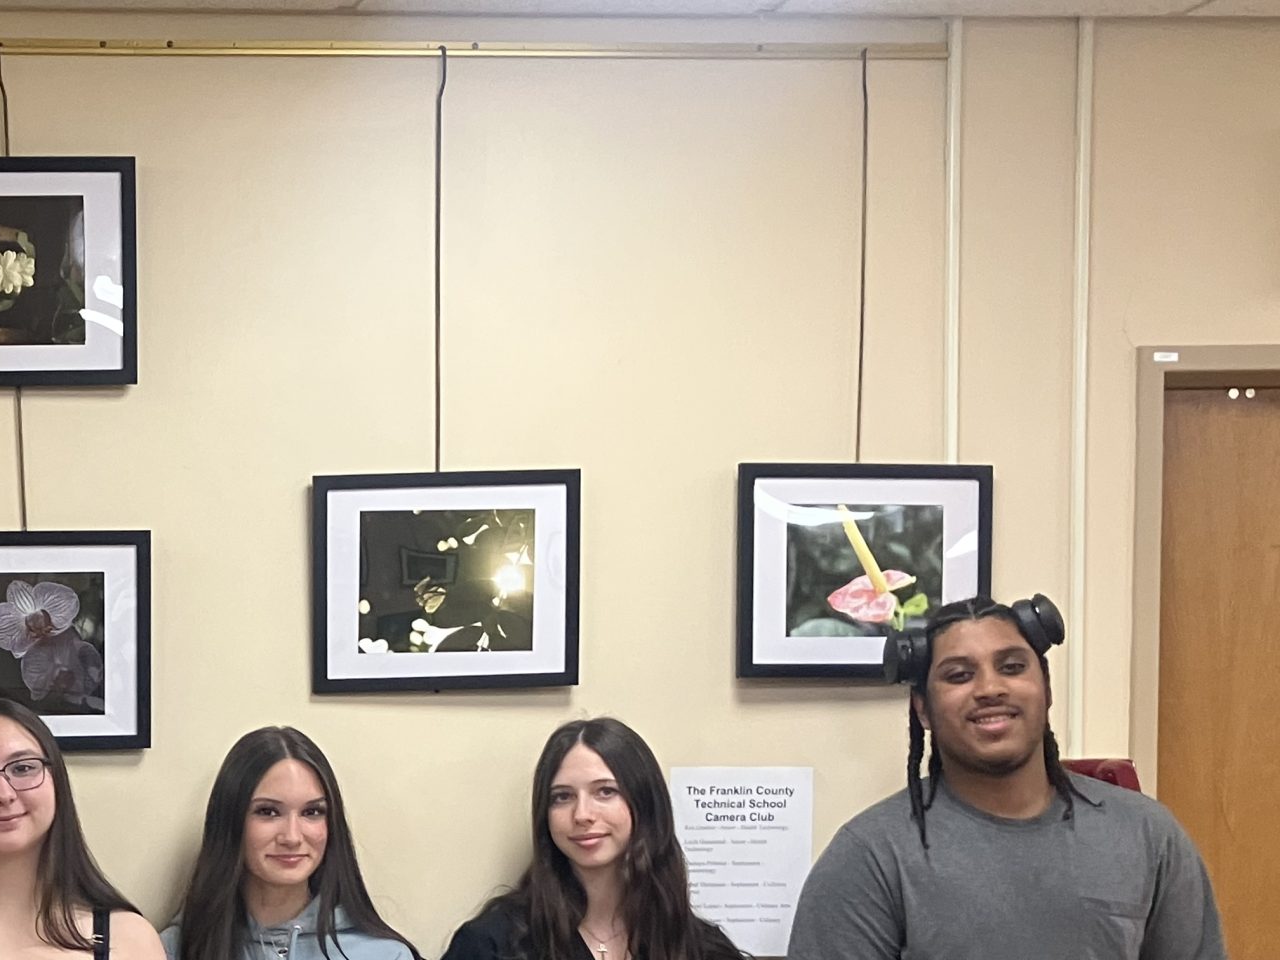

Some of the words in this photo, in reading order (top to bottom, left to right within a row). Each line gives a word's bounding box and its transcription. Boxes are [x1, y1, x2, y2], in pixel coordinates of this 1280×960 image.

[686, 786, 706, 795] The
[709, 786, 753, 795] Franklin
[756, 786, 795, 797] County
[694, 799, 746, 808] Technical
[749, 799, 787, 808] School
[705, 812, 746, 822] Camera
[749, 812, 775, 822] Club
